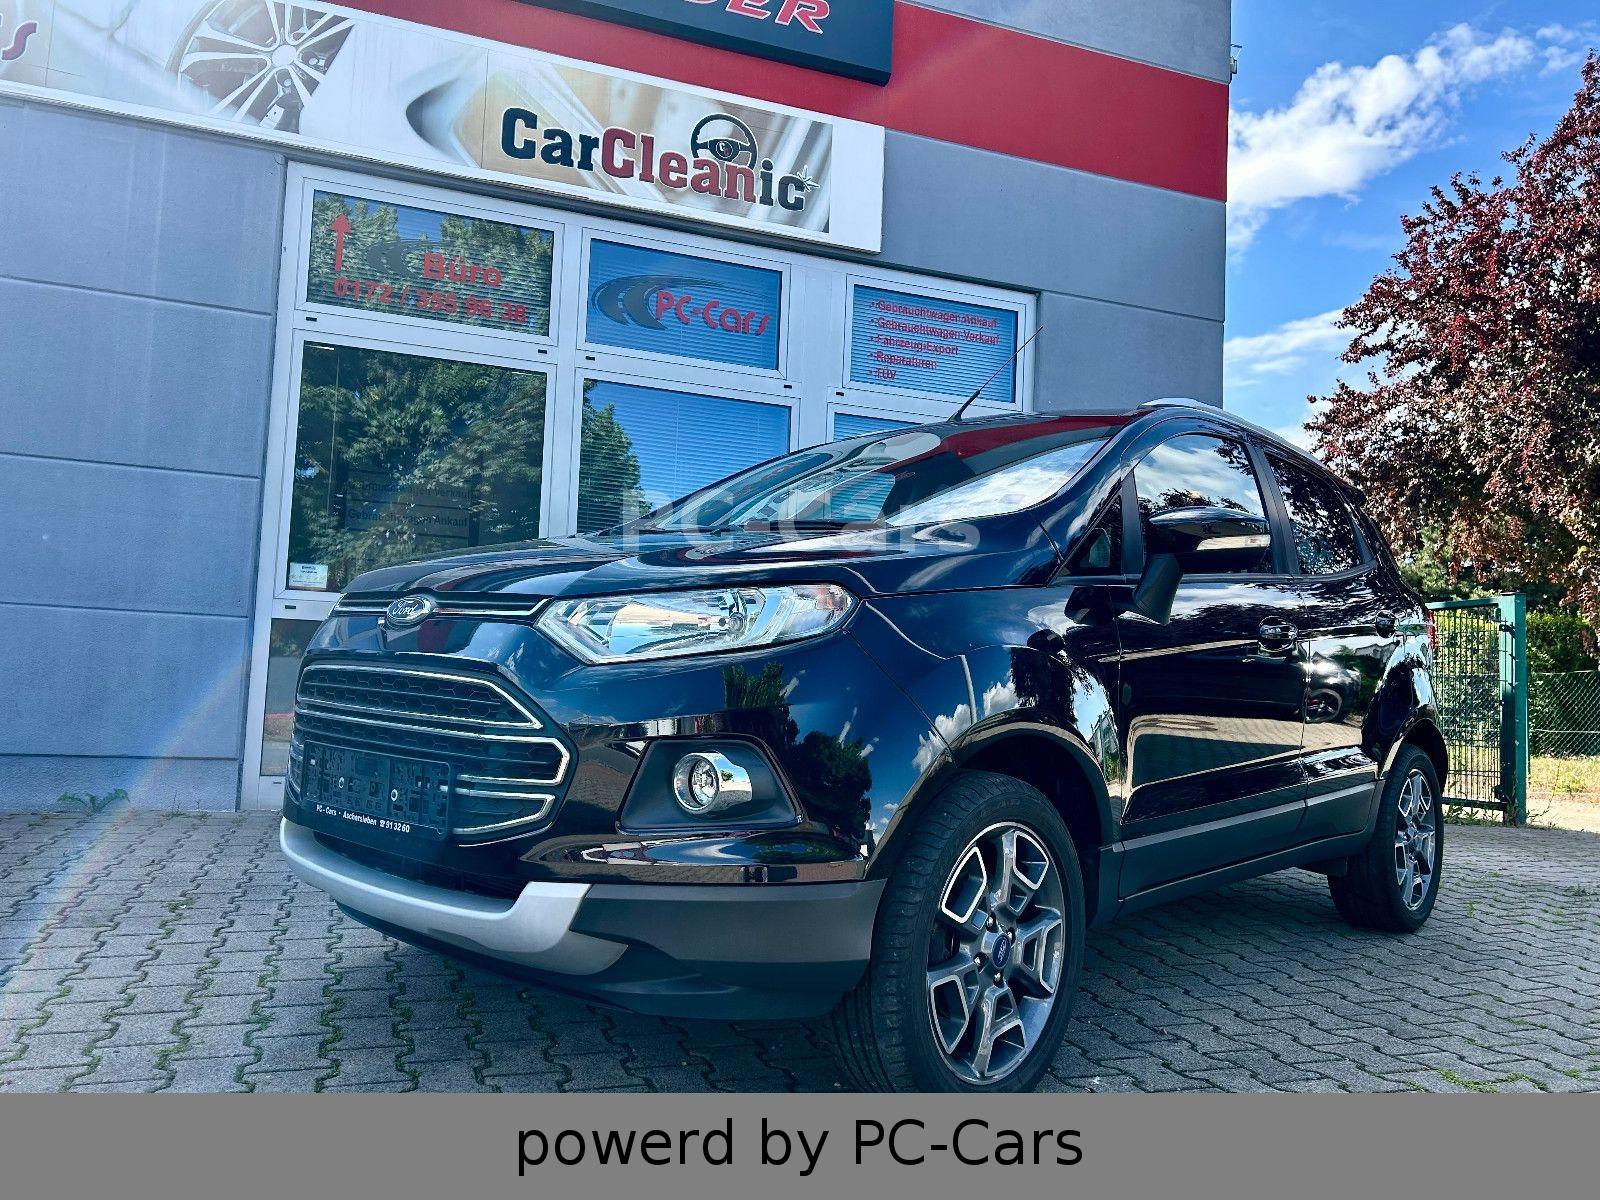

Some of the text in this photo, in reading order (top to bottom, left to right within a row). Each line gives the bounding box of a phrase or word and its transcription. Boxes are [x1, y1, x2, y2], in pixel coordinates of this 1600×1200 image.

[500, 107, 807, 212] CarCleanic
[423, 251, 502, 287] Büro
[332, 276, 394, 304] 0172
[656, 290, 771, 335] PC-Cars
[392, 600, 419, 615] Ford
